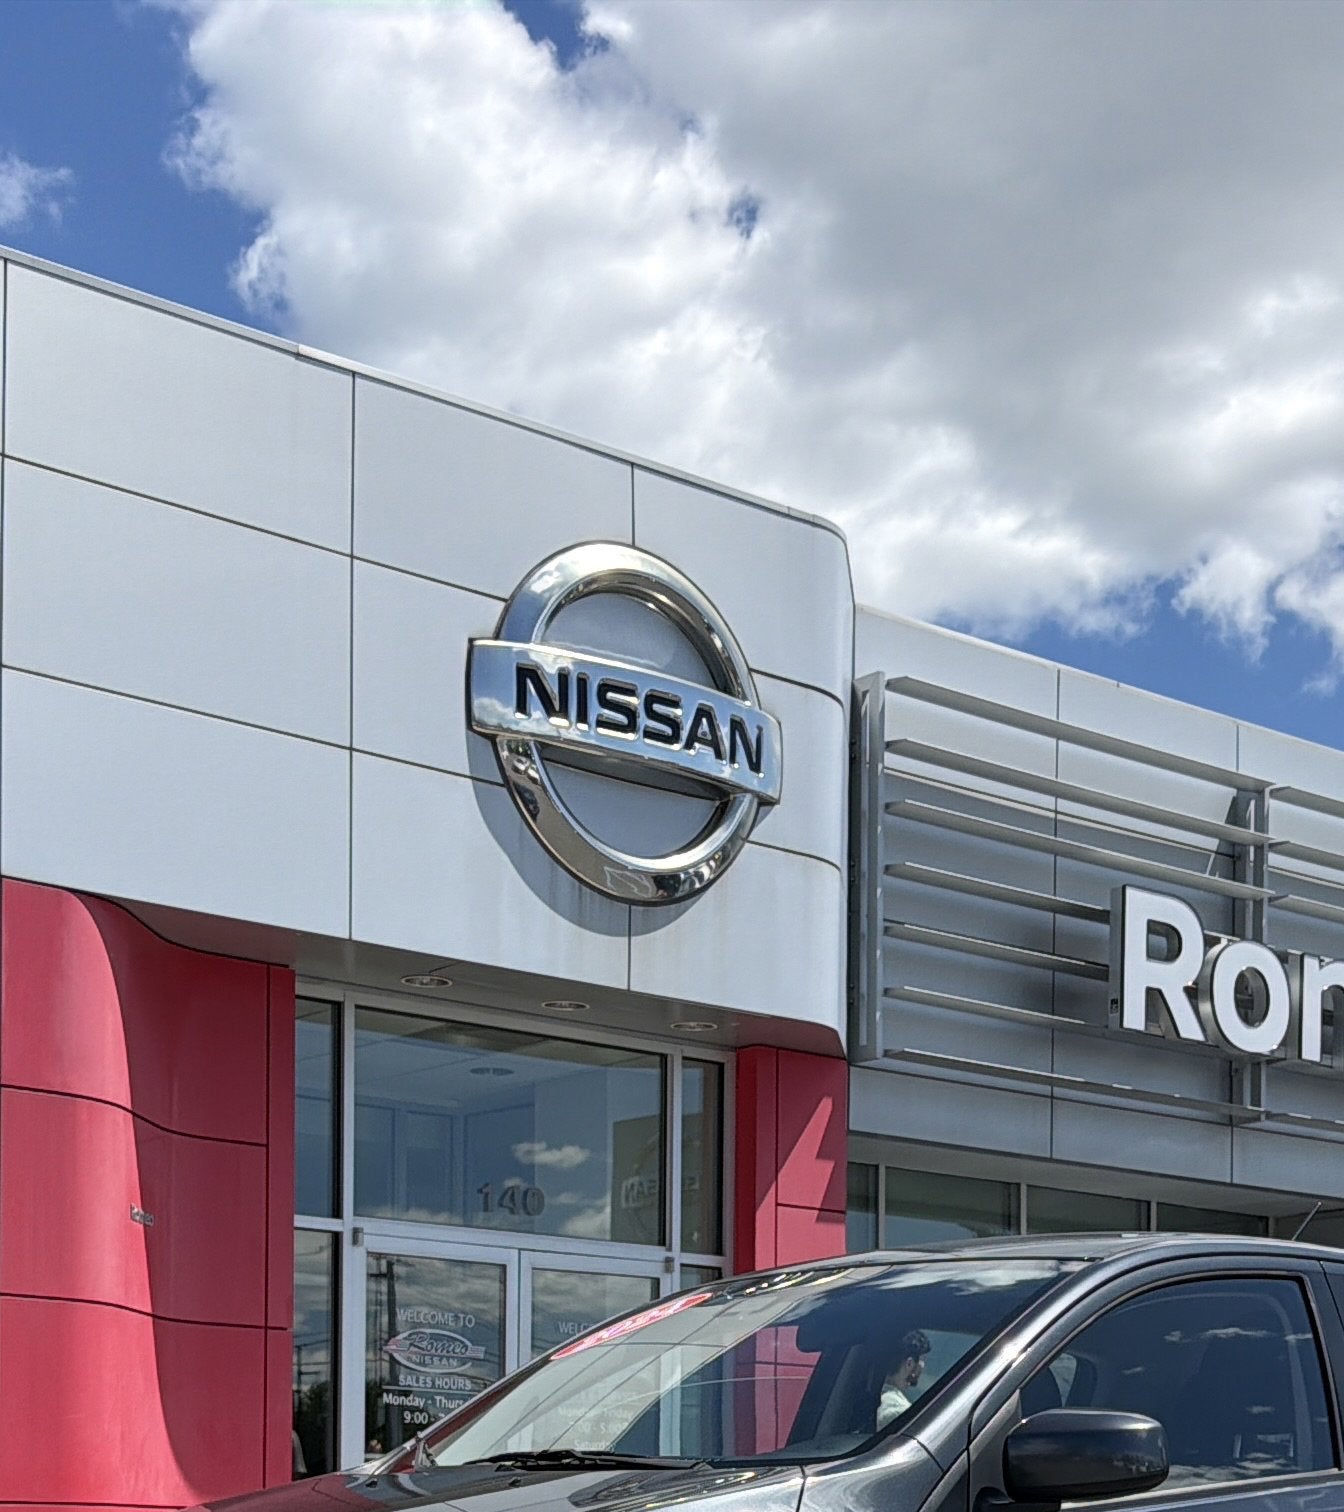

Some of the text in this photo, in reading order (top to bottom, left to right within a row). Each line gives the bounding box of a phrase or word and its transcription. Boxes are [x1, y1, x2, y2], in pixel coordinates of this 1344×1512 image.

[515, 662, 765, 778] NISSAN
[477, 1182, 545, 1216] 140
[398, 1309, 475, 1328] WELCOME TO
[558, 1321, 595, 1335] WELC
[405, 1331, 469, 1355] Romeo
[411, 1356, 458, 1367] NISSAN
[399, 1375, 472, 1391] SALES HOURS
[382, 1392, 426, 1409] Monday
[404, 1411, 429, 1424] 9:00
